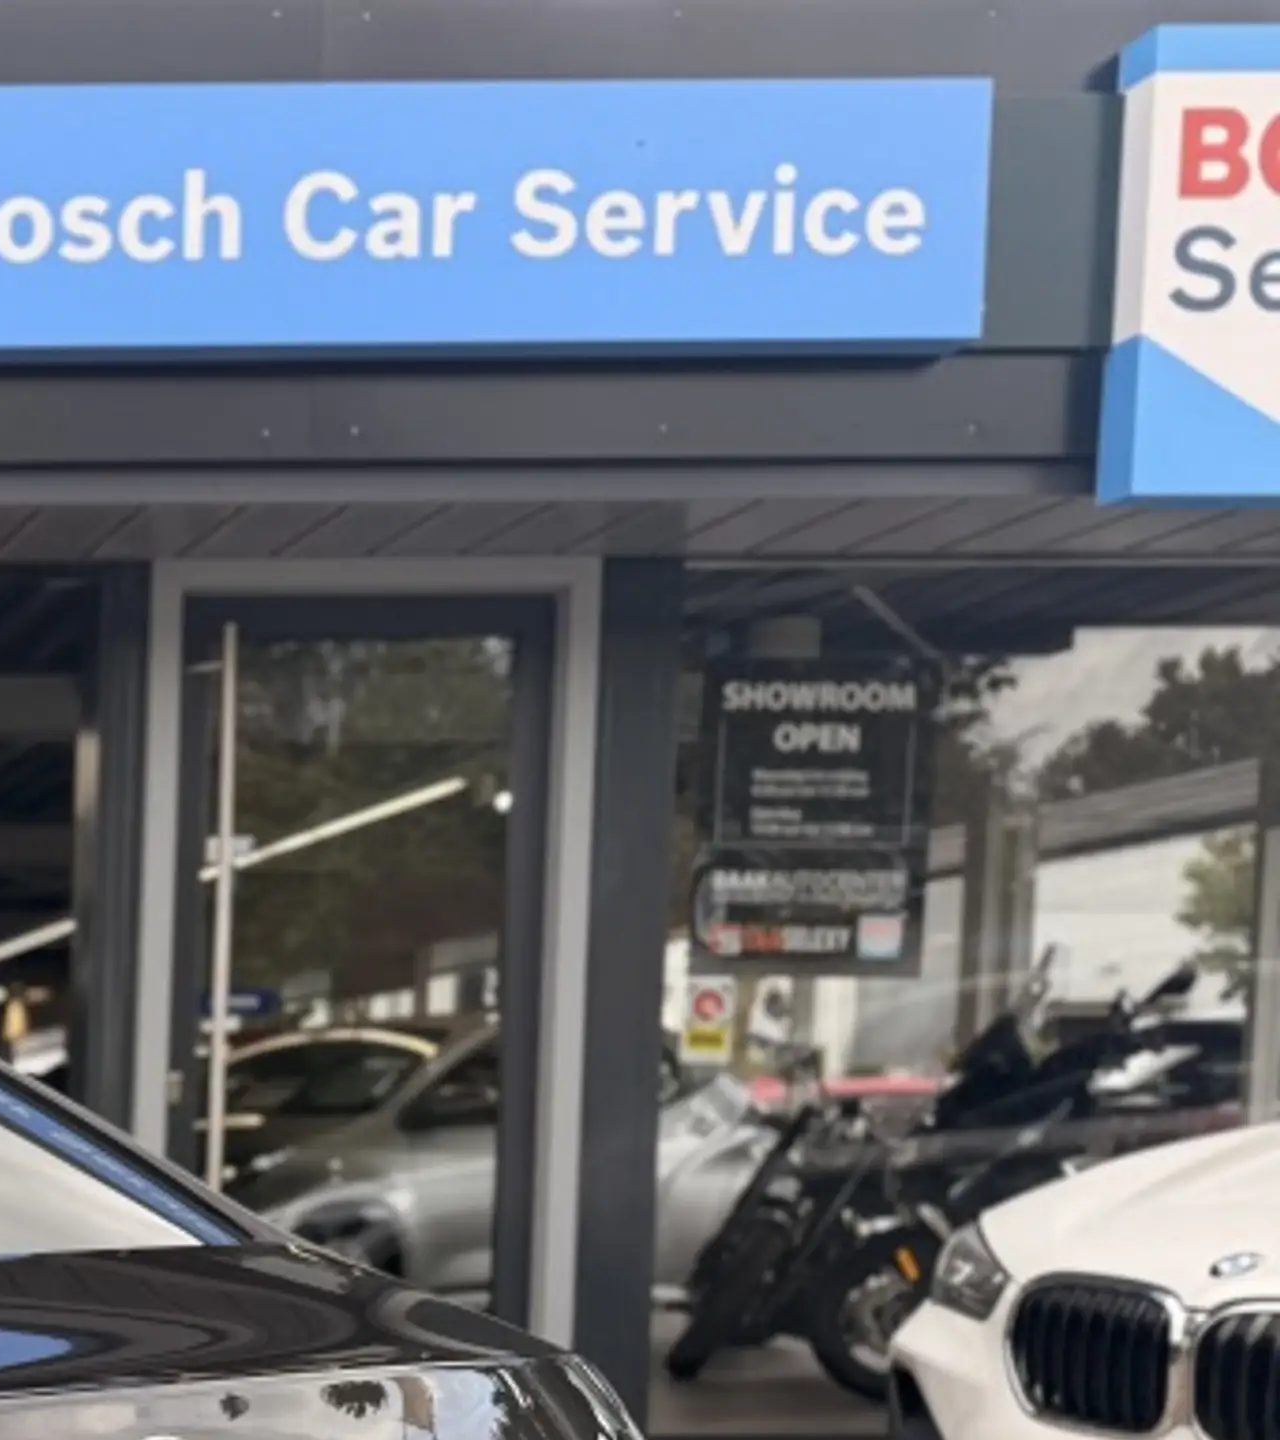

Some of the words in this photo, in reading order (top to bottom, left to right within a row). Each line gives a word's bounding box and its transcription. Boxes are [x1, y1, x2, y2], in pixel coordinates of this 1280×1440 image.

[282, 170, 476, 260] Car
[510, 163, 928, 258] Service
[721, 681, 917, 712] SHOWROOM
[772, 722, 862, 753] OPEN
